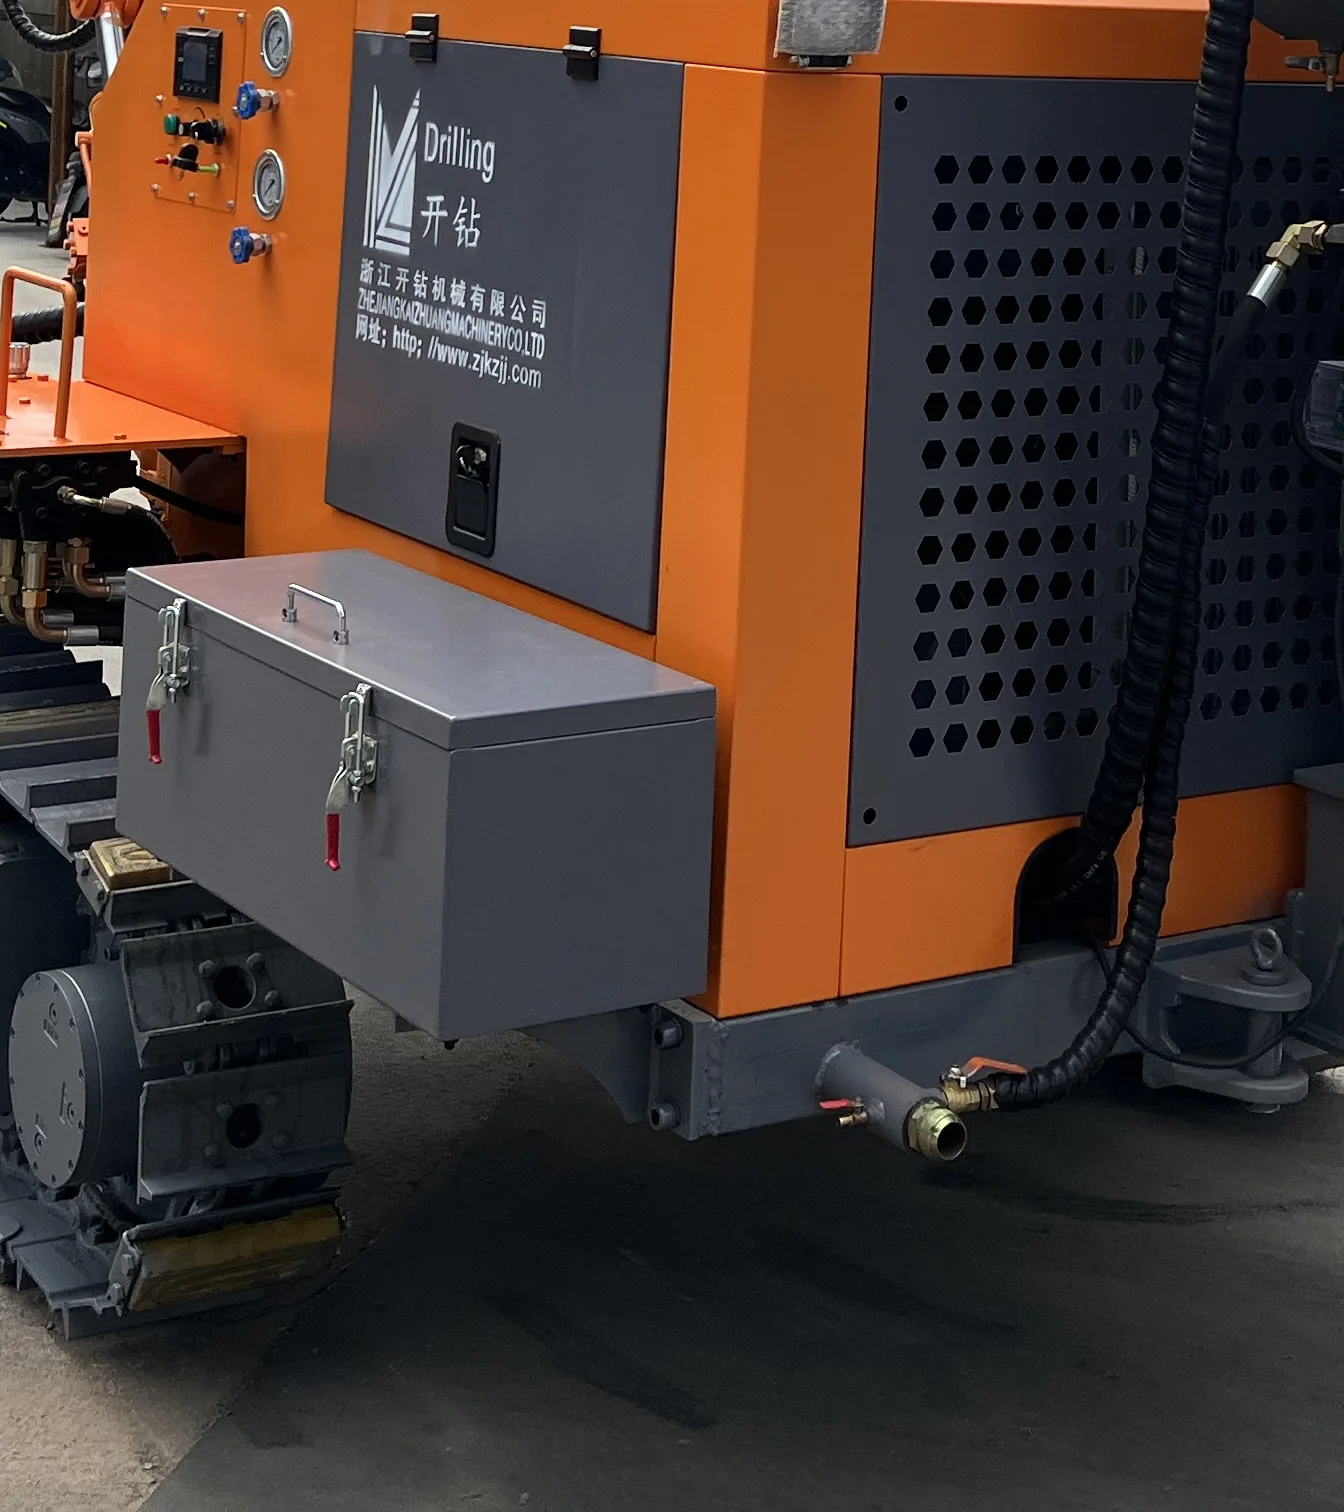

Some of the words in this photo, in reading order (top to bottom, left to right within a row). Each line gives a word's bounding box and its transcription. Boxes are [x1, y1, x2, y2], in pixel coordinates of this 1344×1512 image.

[424, 122, 495, 182] Drilling
[420, 194, 481, 249] 开钻
[358, 257, 548, 330] 浙江开钻机械有限公司
